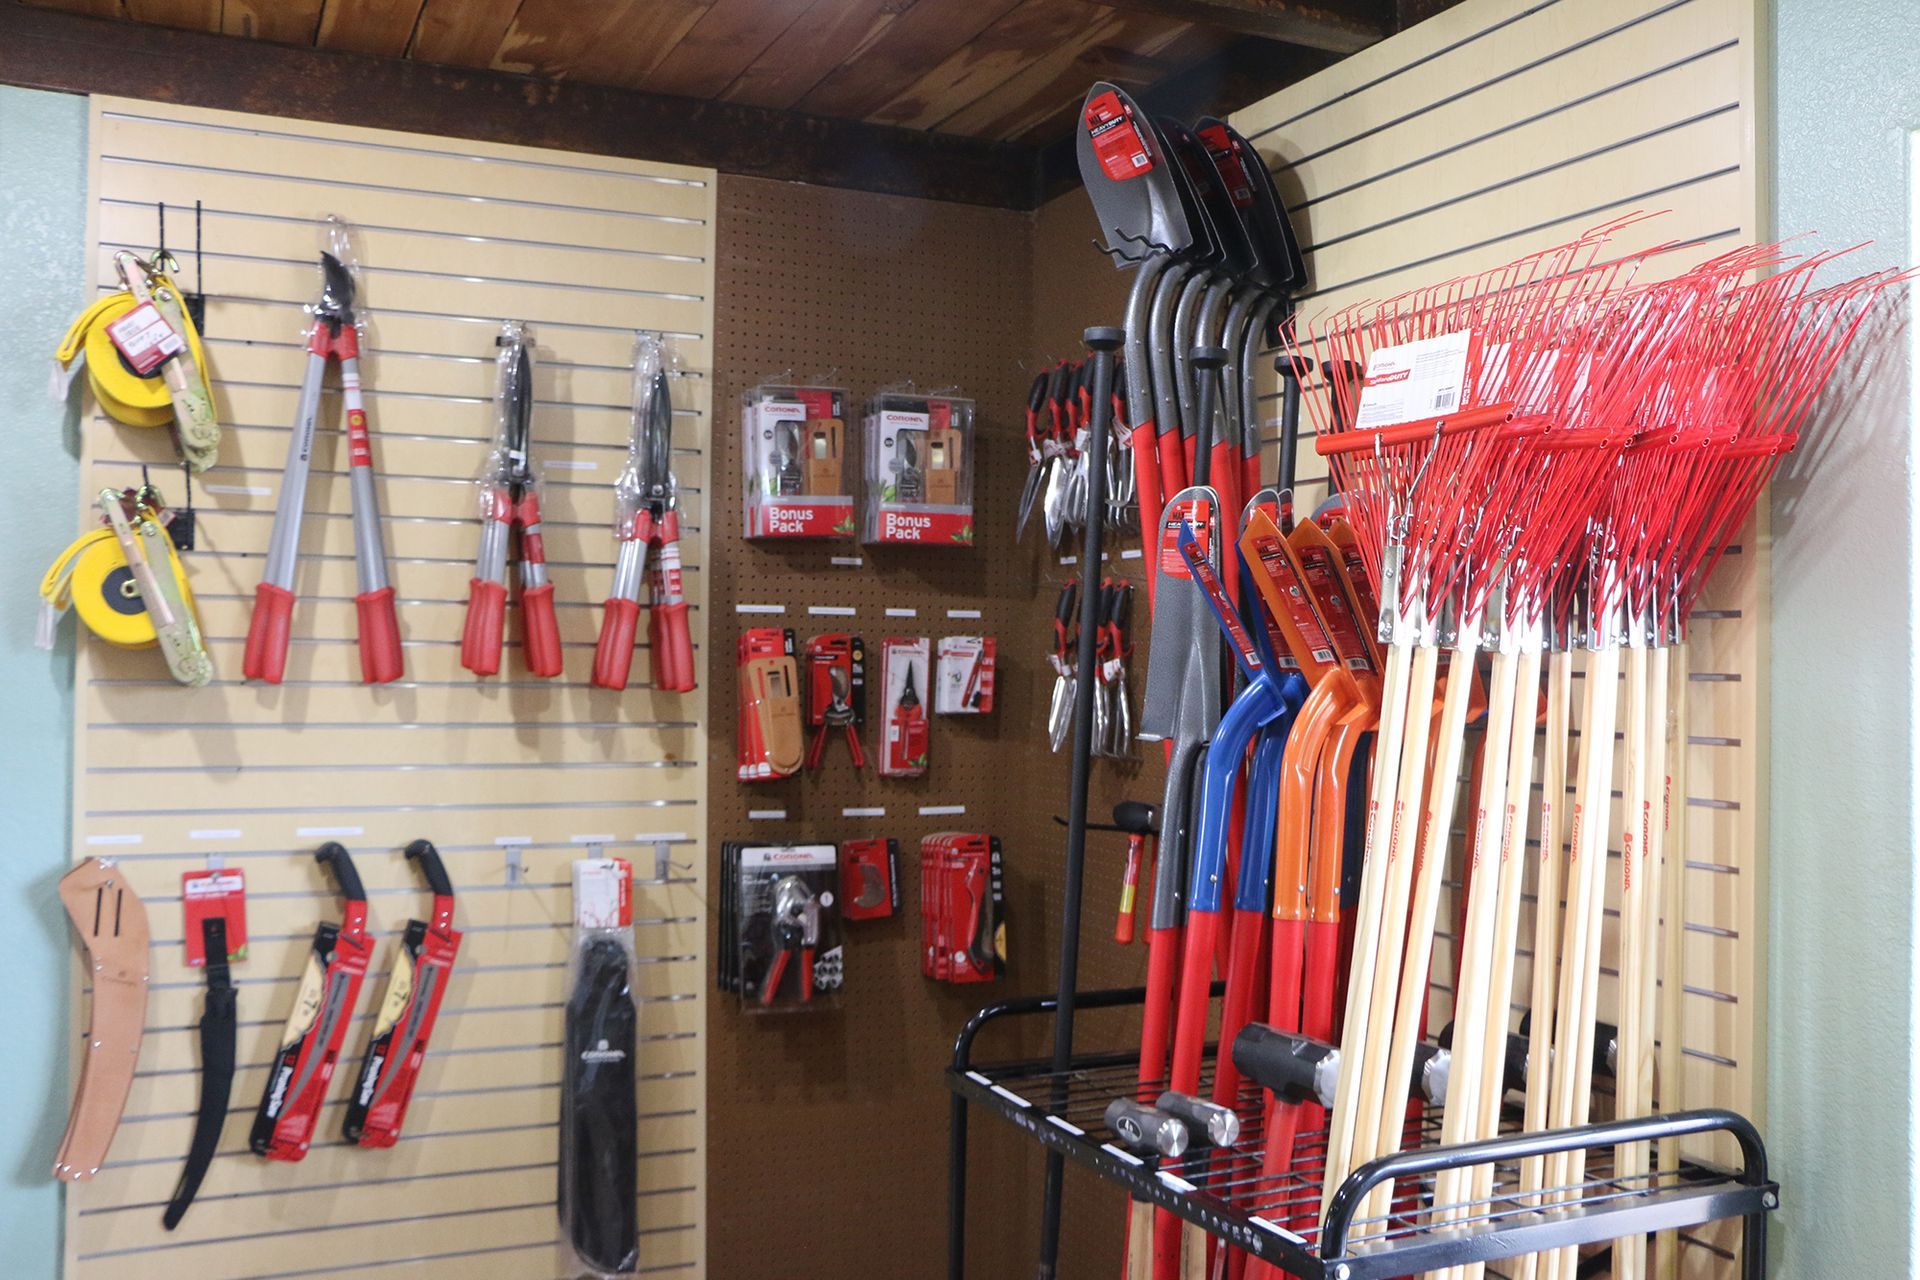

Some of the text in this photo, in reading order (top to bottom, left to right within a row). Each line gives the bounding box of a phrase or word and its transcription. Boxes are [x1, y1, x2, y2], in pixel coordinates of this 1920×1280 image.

[769, 506, 814, 521] Bonus
[886, 513, 931, 528] Bonus
[769, 519, 804, 533] Pack
[886, 526, 920, 540] Pack
